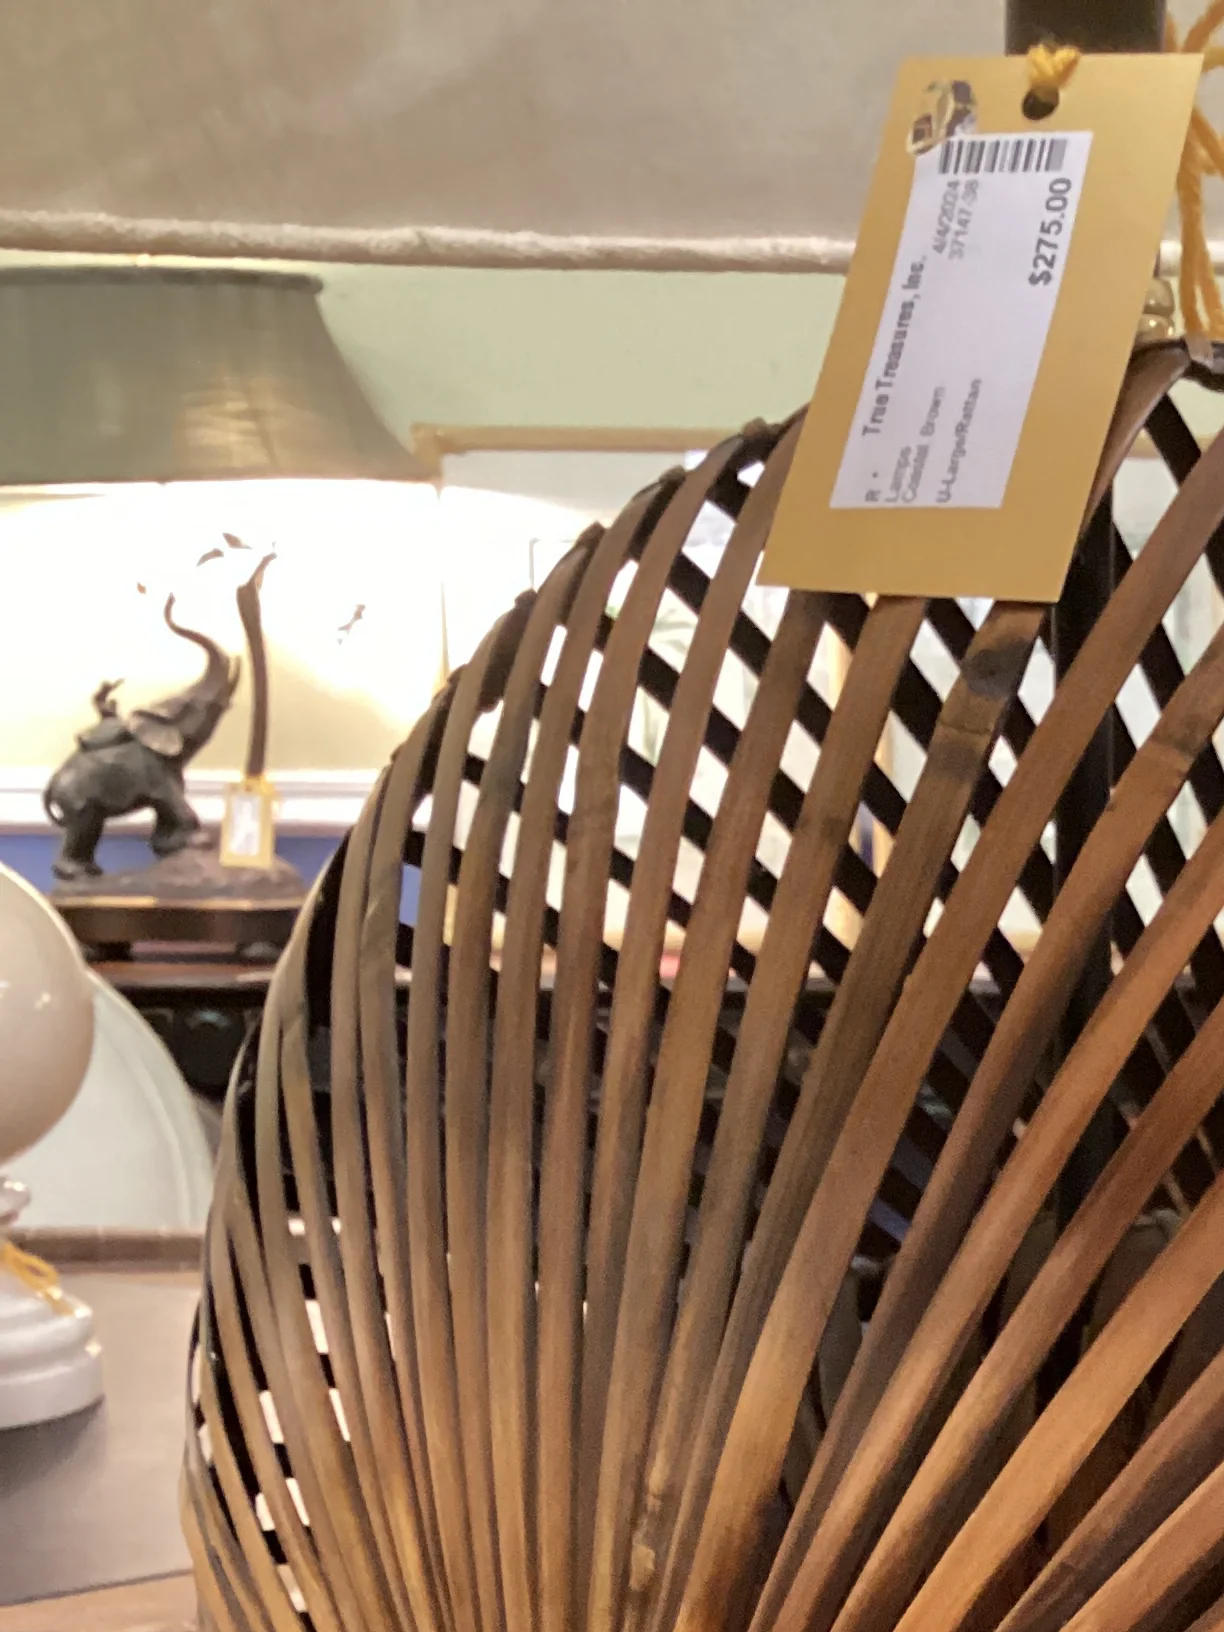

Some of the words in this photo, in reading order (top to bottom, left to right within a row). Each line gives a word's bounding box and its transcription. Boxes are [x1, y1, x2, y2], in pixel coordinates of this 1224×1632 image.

[1028, 177, 1072, 286] $275.00
[901, 255, 927, 290] Inc.
[875, 293, 921, 391] Treasures,
[862, 394, 889, 436] True
[919, 386, 945, 437] Brown
[884, 446, 912, 503] Lamps
